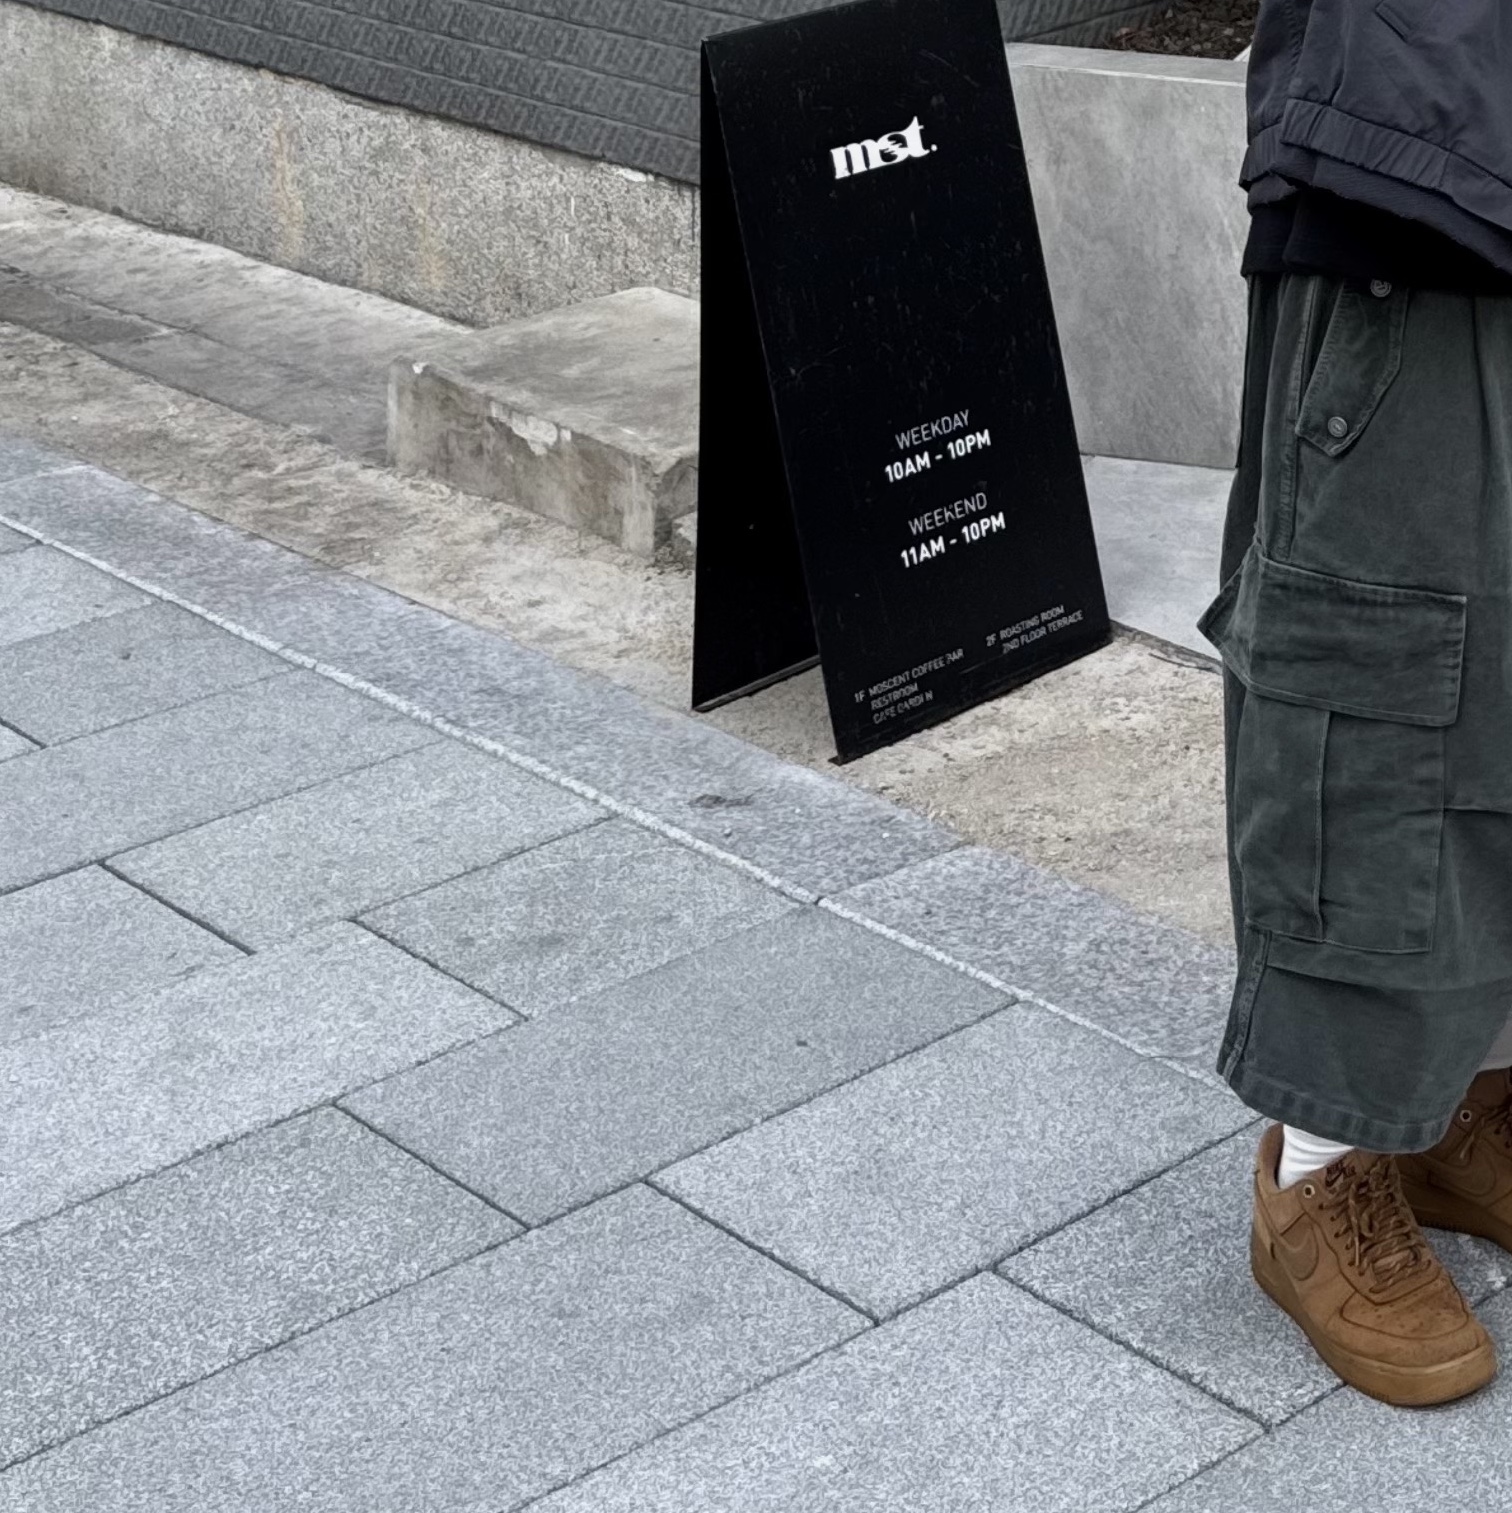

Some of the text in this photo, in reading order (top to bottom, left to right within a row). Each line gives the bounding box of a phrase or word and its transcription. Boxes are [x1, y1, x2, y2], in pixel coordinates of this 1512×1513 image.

[895, 409, 969, 450] WEEKDAY
[885, 451, 931, 483] 10AM
[947, 429, 991, 460] 10PM
[908, 492, 988, 535] WEEKEND
[901, 535, 946, 568] 11AM
[961, 511, 1006, 544] 10PM
[1000, 615, 1040, 640] ROASTING
[1040, 604, 1065, 622] ROOM
[1020, 626, 1047, 646] FLOOR
[1047, 609, 1084, 633] TERRACE
[868, 670, 910, 696] MOSCENT
[911, 656, 946, 678] COFFEE
[871, 682, 919, 710] RESTROOM
